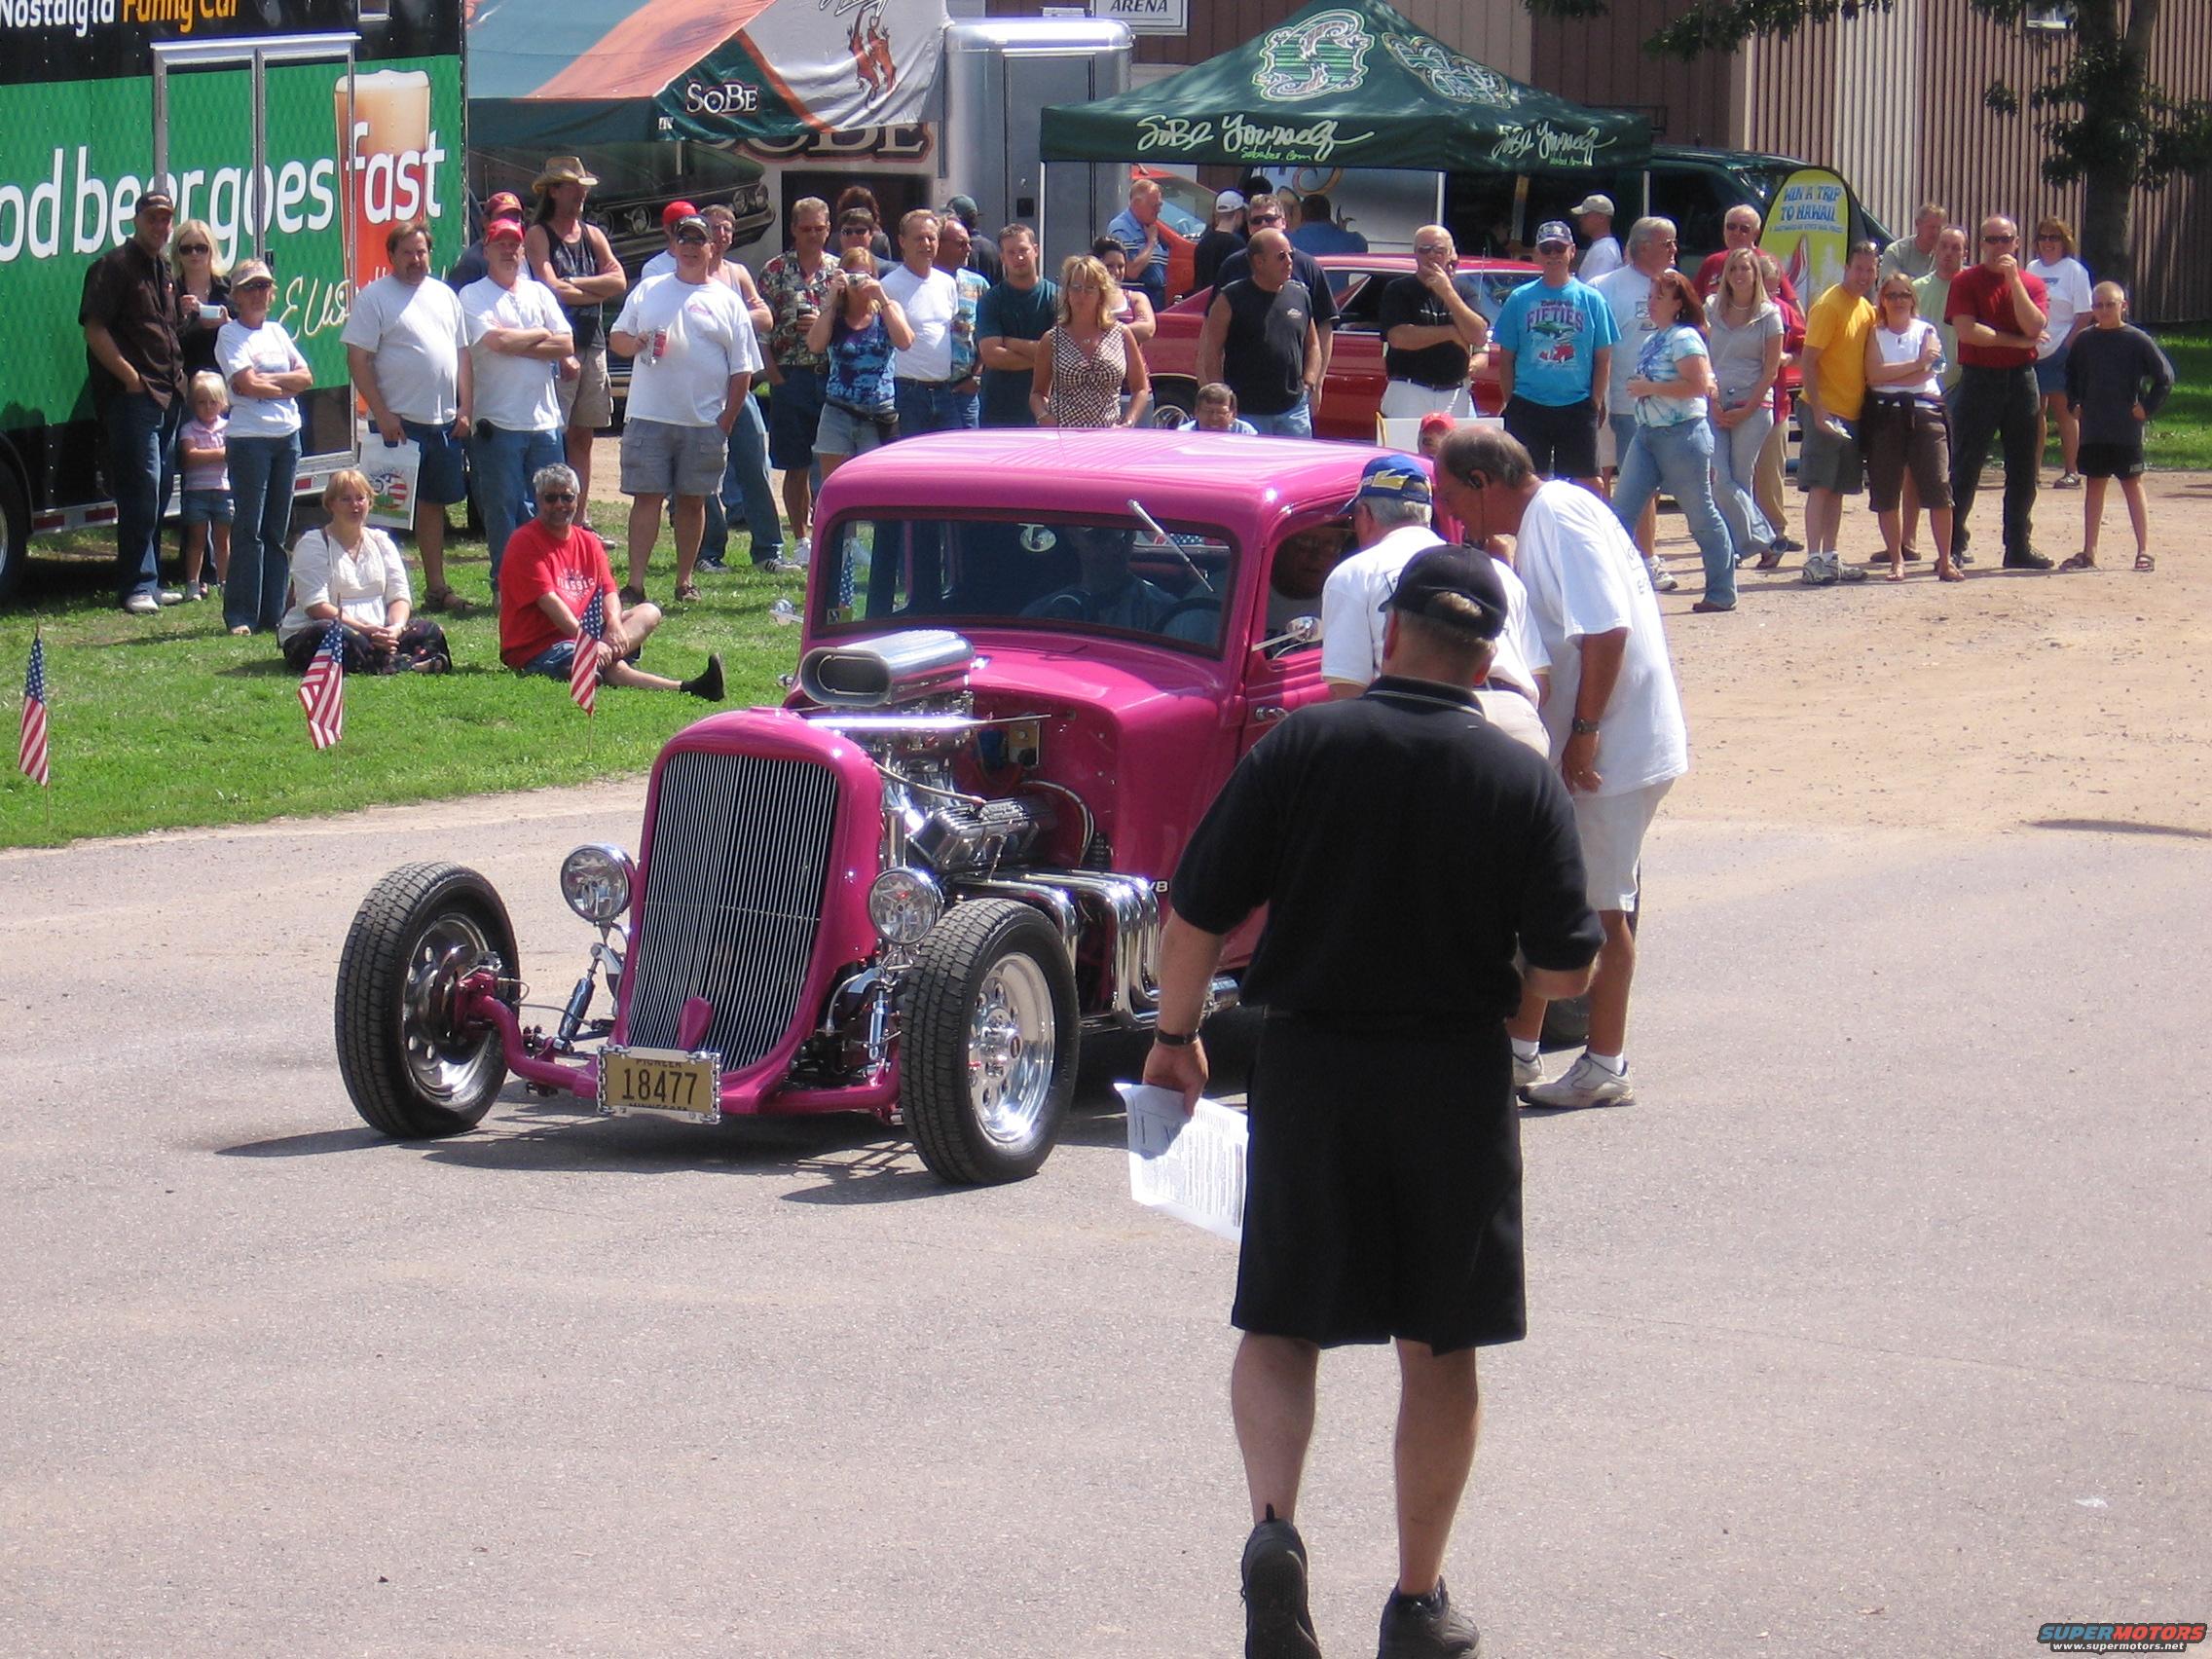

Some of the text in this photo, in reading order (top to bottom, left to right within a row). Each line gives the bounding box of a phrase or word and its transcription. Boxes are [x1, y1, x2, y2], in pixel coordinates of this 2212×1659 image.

[122, 0, 194, 33] Funny
[1110, 0, 1168, 13] ARENA
[208, 158, 335, 273] goes
[346, 121, 446, 225] fast
[1783, 185, 1842, 203] WIN A TRIP
[1780, 203, 1835, 222] TO HAWAII
[1526, 307, 1584, 333] FIFTIES
[622, 1067, 698, 1105] 18477
